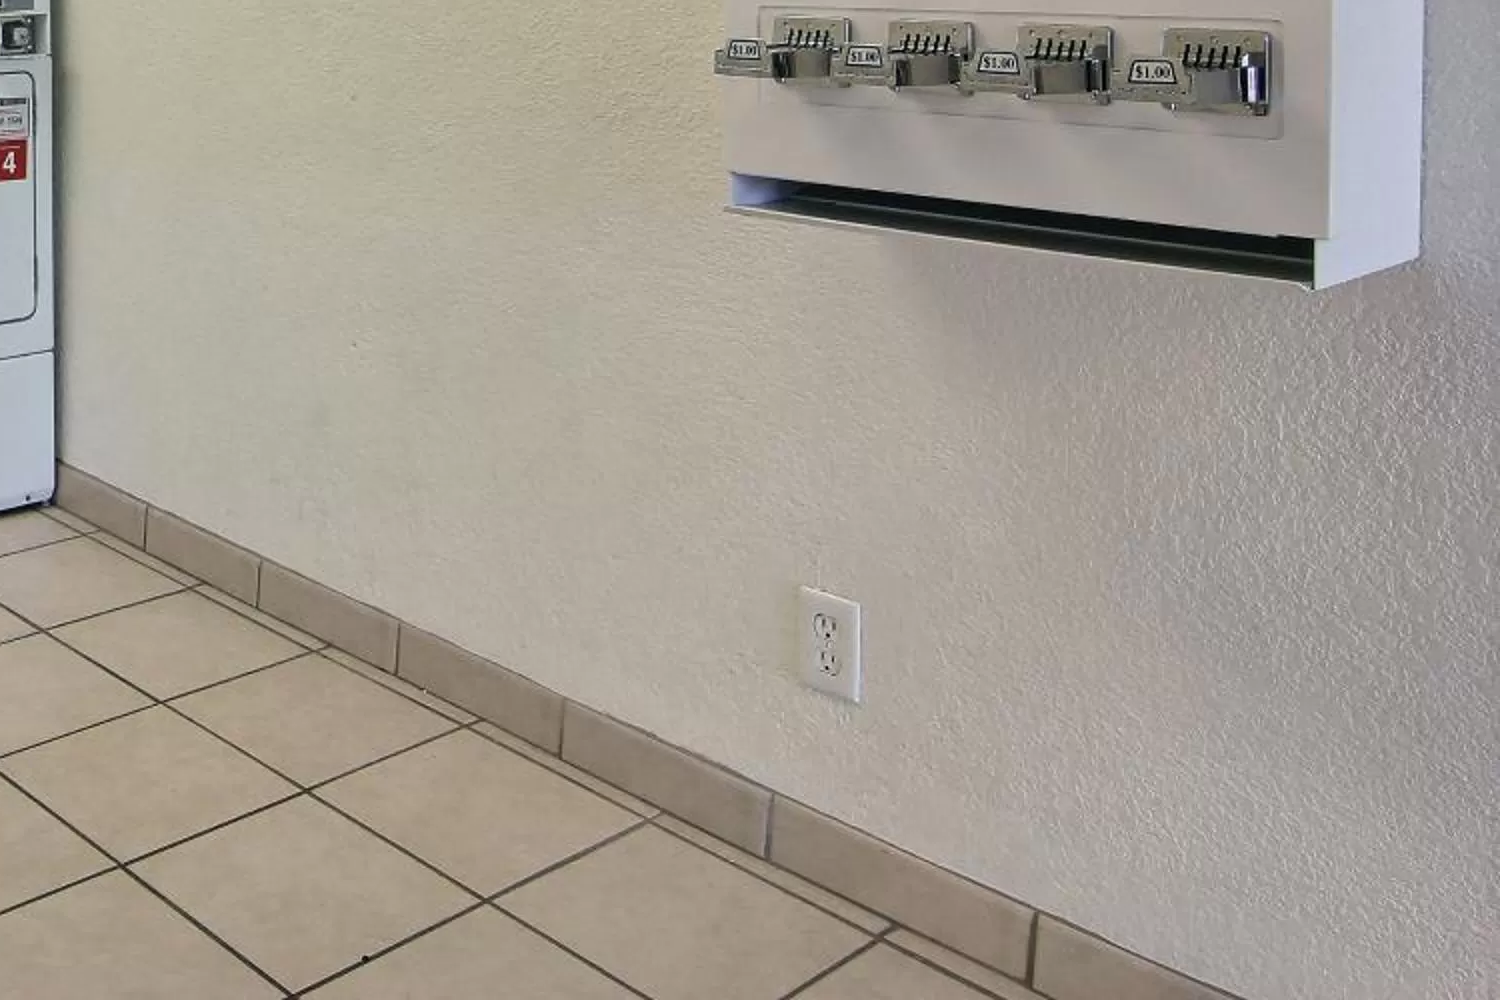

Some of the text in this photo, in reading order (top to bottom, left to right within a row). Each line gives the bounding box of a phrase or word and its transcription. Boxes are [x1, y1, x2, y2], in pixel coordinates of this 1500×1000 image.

[983, 56, 1015, 70] $1.00
[1135, 65, 1171, 80] $1.00
[2, 151, 17, 174] 4
